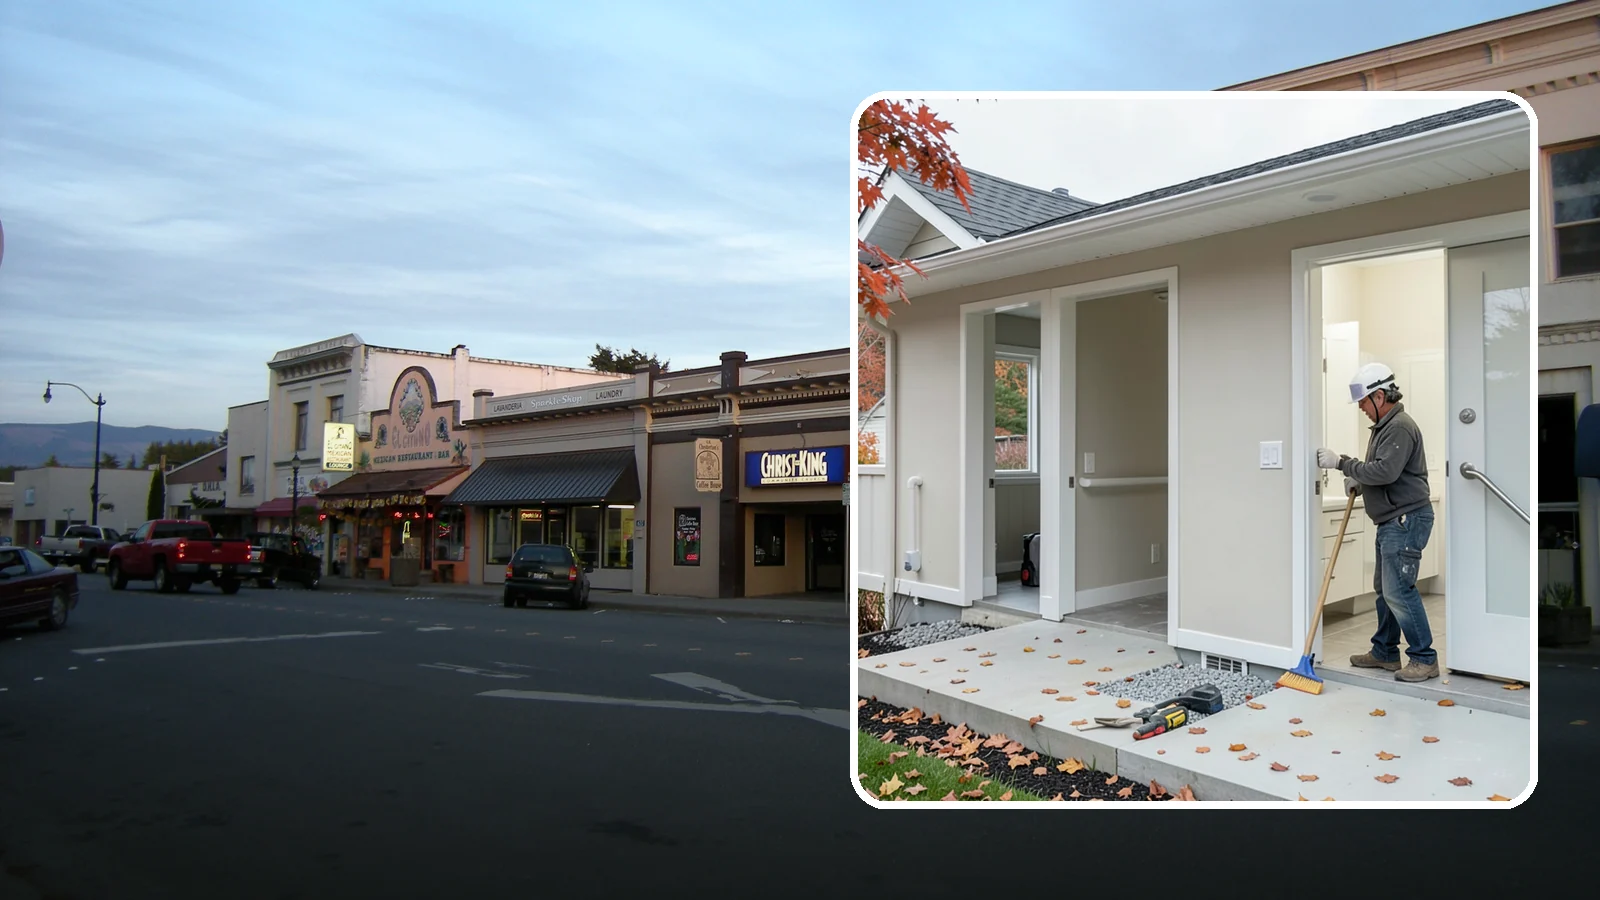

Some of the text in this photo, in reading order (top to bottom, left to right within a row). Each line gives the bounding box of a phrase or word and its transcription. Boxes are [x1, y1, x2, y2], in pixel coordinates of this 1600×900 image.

[530, 394, 582, 408] Sparkle Shop
[595, 388, 623, 400] LAUNDRY
[493, 402, 522, 413] LAVANDERIA
[374, 455, 395, 464] MEXICAN
[397, 451, 433, 462] RESTAURANT
[438, 450, 450, 459] BAR
[760, 450, 827, 478] CHRIST KING
